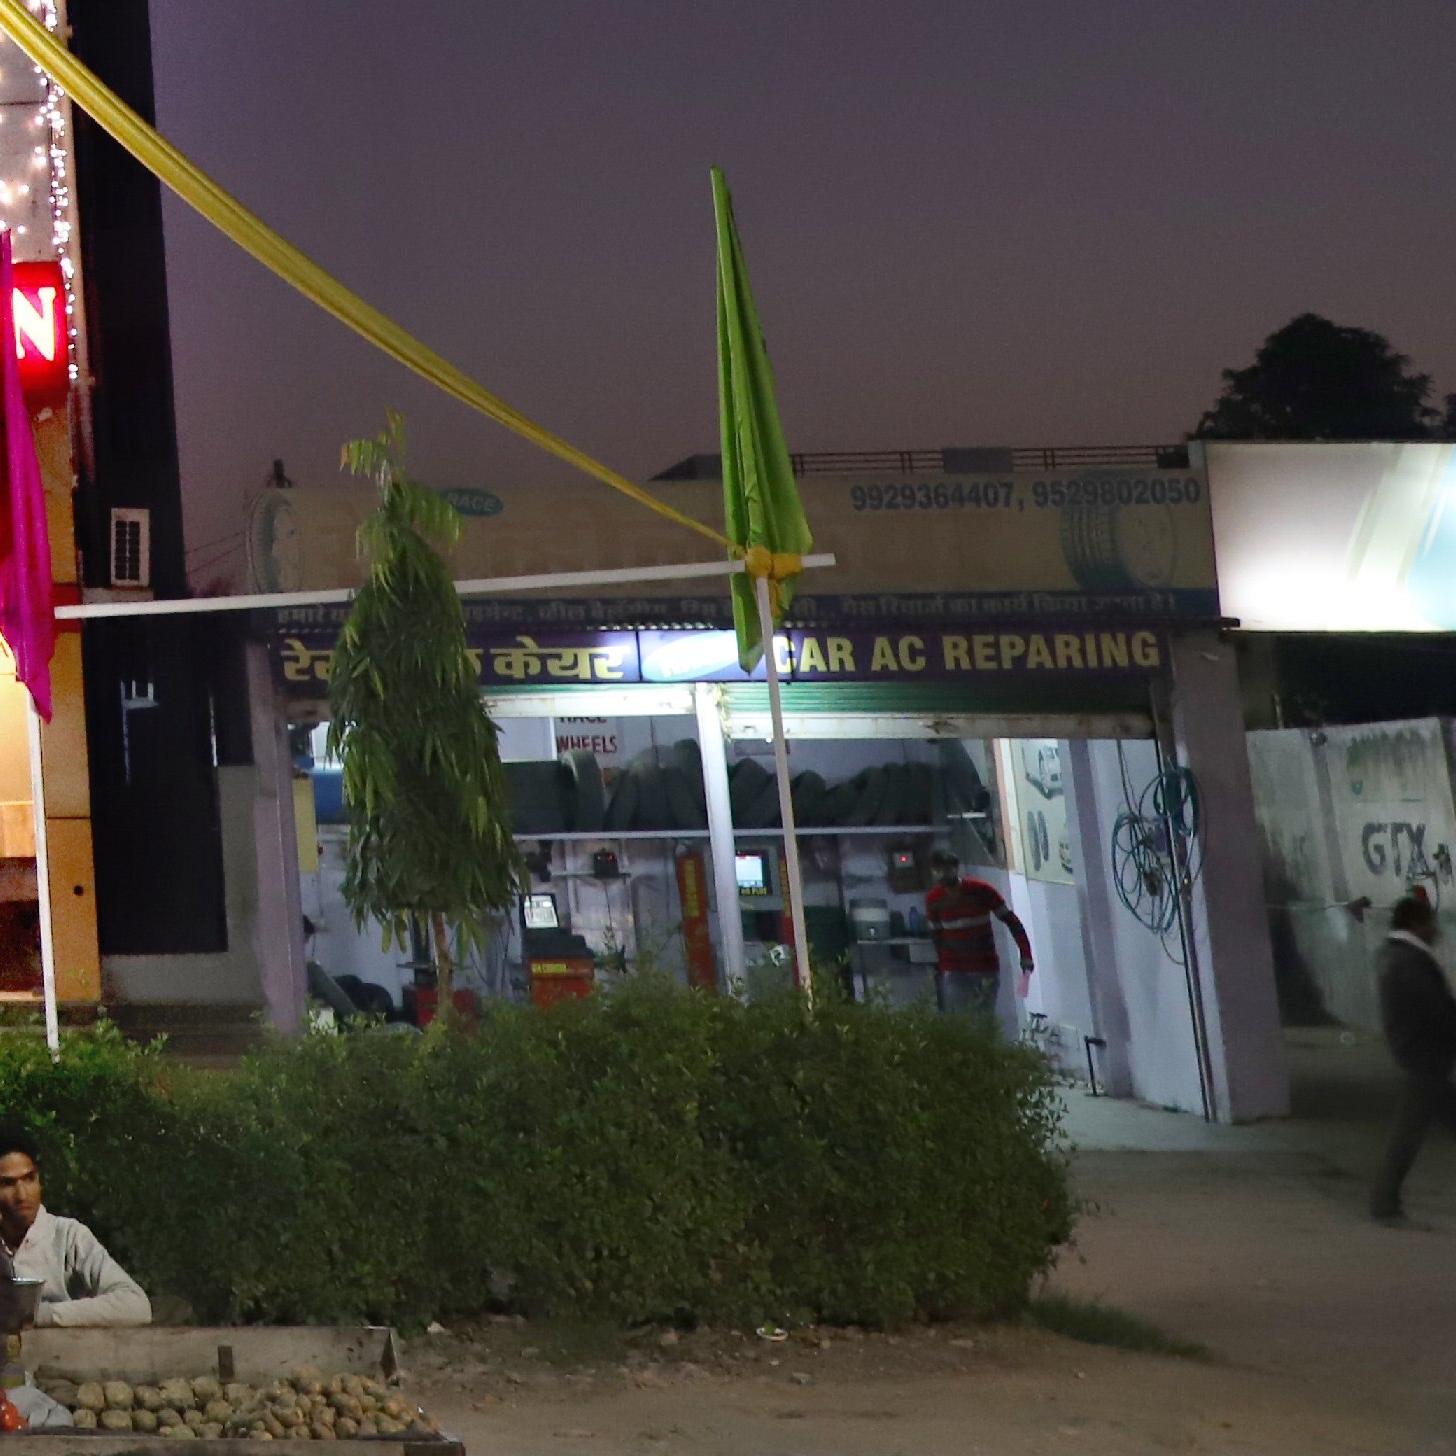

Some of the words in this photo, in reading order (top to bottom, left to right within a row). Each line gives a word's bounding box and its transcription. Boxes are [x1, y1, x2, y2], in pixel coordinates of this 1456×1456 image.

[489, 635, 631, 681] केयर
[772, 635, 856, 674] CAR
[871, 636, 927, 672] AC
[944, 632, 1161, 671] REPARING
[557, 734, 618, 754] WHEELS
